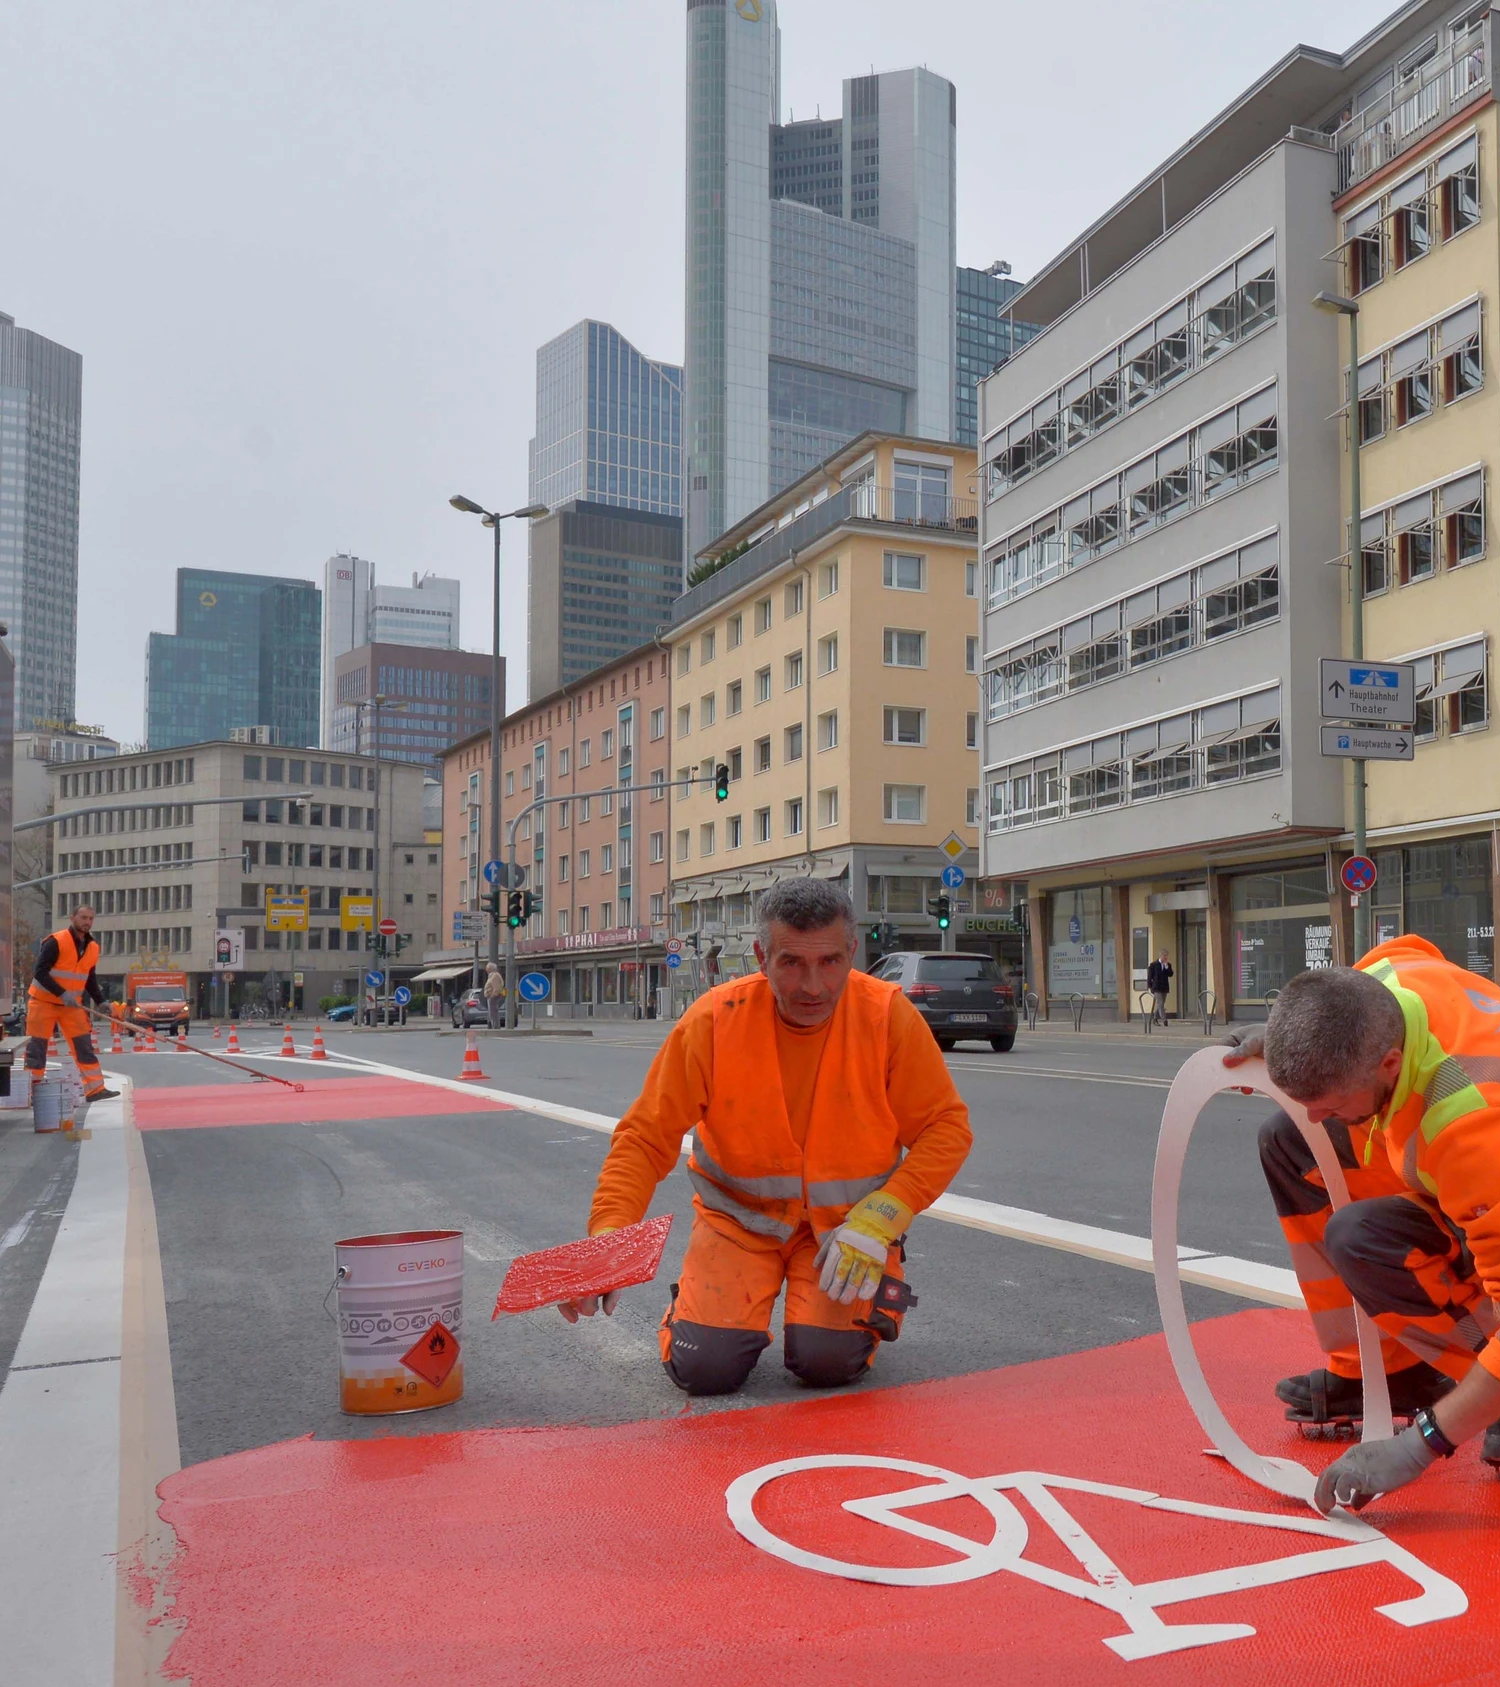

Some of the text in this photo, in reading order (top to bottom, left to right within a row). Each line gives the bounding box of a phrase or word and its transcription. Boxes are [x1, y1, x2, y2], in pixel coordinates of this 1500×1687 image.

[1349, 689, 1399, 702] Hauptbahnhof
[1350, 702, 1388, 714] Theater
[1353, 738, 1391, 750] Hauptwache
[966, 918, 1022, 932] BÜCHE
[669, 941, 679, 949] 40
[1306, 949, 1325, 961] UMBAU
[397, 1258, 445, 1273] GEVEKO
[435, 1376, 441, 1384] 3
